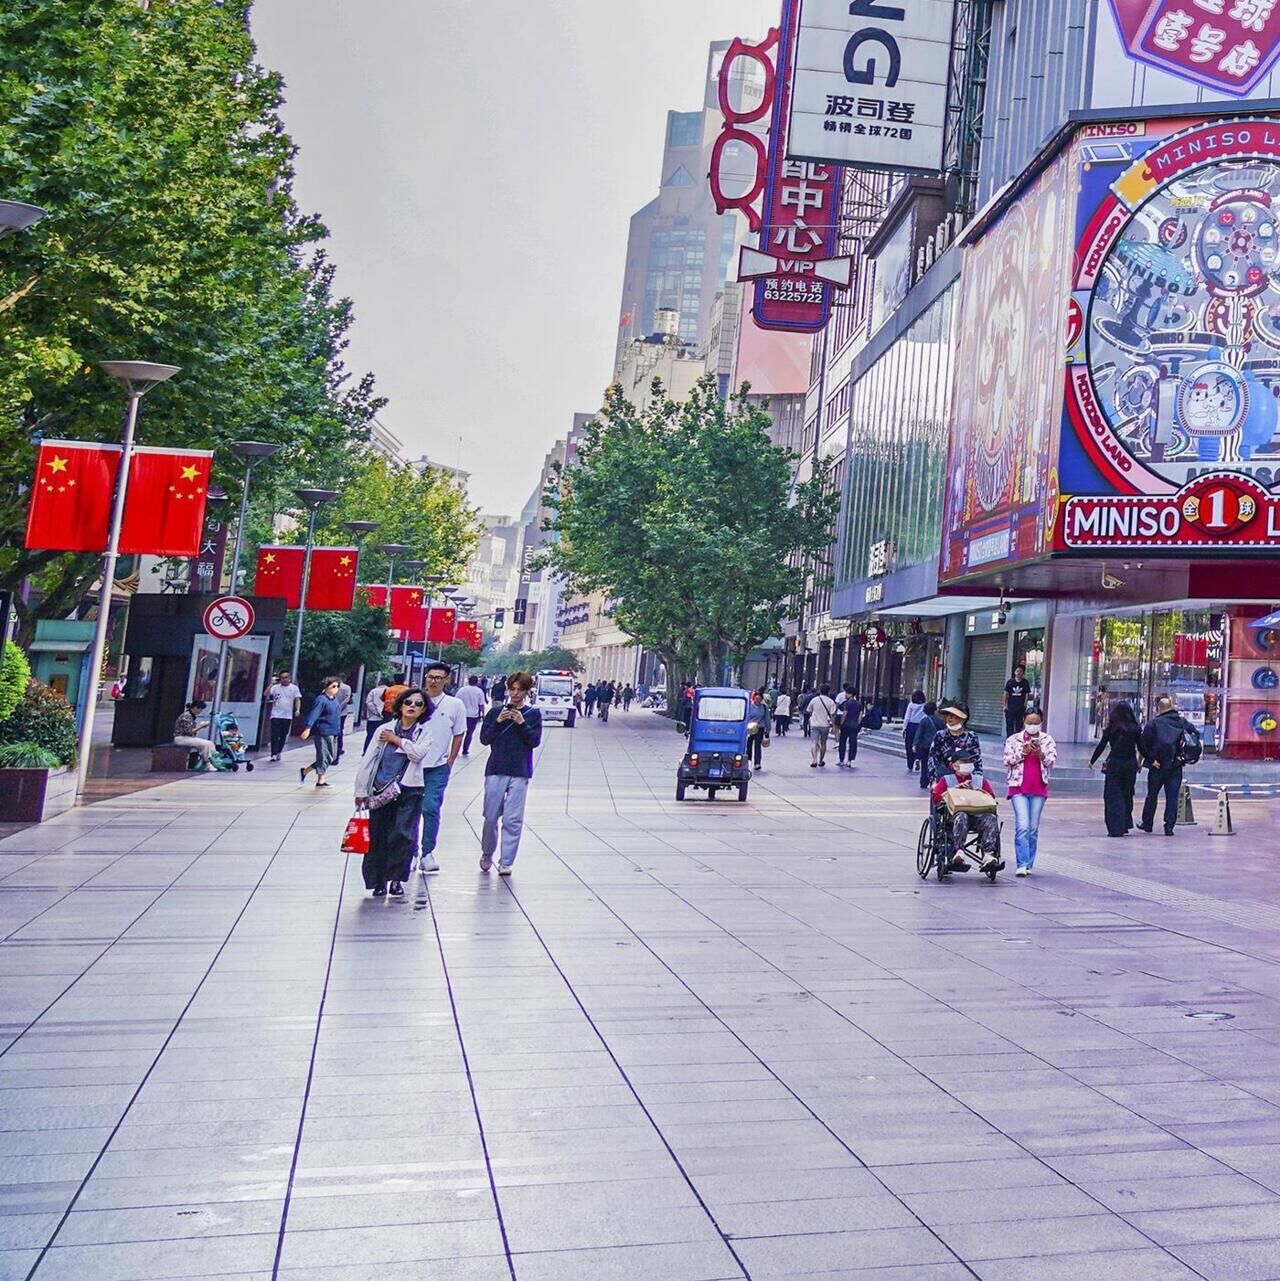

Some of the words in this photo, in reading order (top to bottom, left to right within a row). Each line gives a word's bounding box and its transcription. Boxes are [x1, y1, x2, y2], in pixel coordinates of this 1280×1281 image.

[1153, 9, 1260, 77] 壹号店
[825, 95, 915, 124] 波司登
[1156, 131, 1250, 169] MINISO
[779, 259, 814, 273] VIP
[764, 291, 823, 304] 63225722
[765, 278, 823, 293] 预约电话
[1077, 373, 1105, 438] MINISO
[1102, 432, 1133, 474] LAND
[1073, 496, 1180, 538] MINISO
[1184, 501, 1197, 518] 全
[1205, 489, 1228, 529] 1
[1239, 501, 1253, 517] 球
